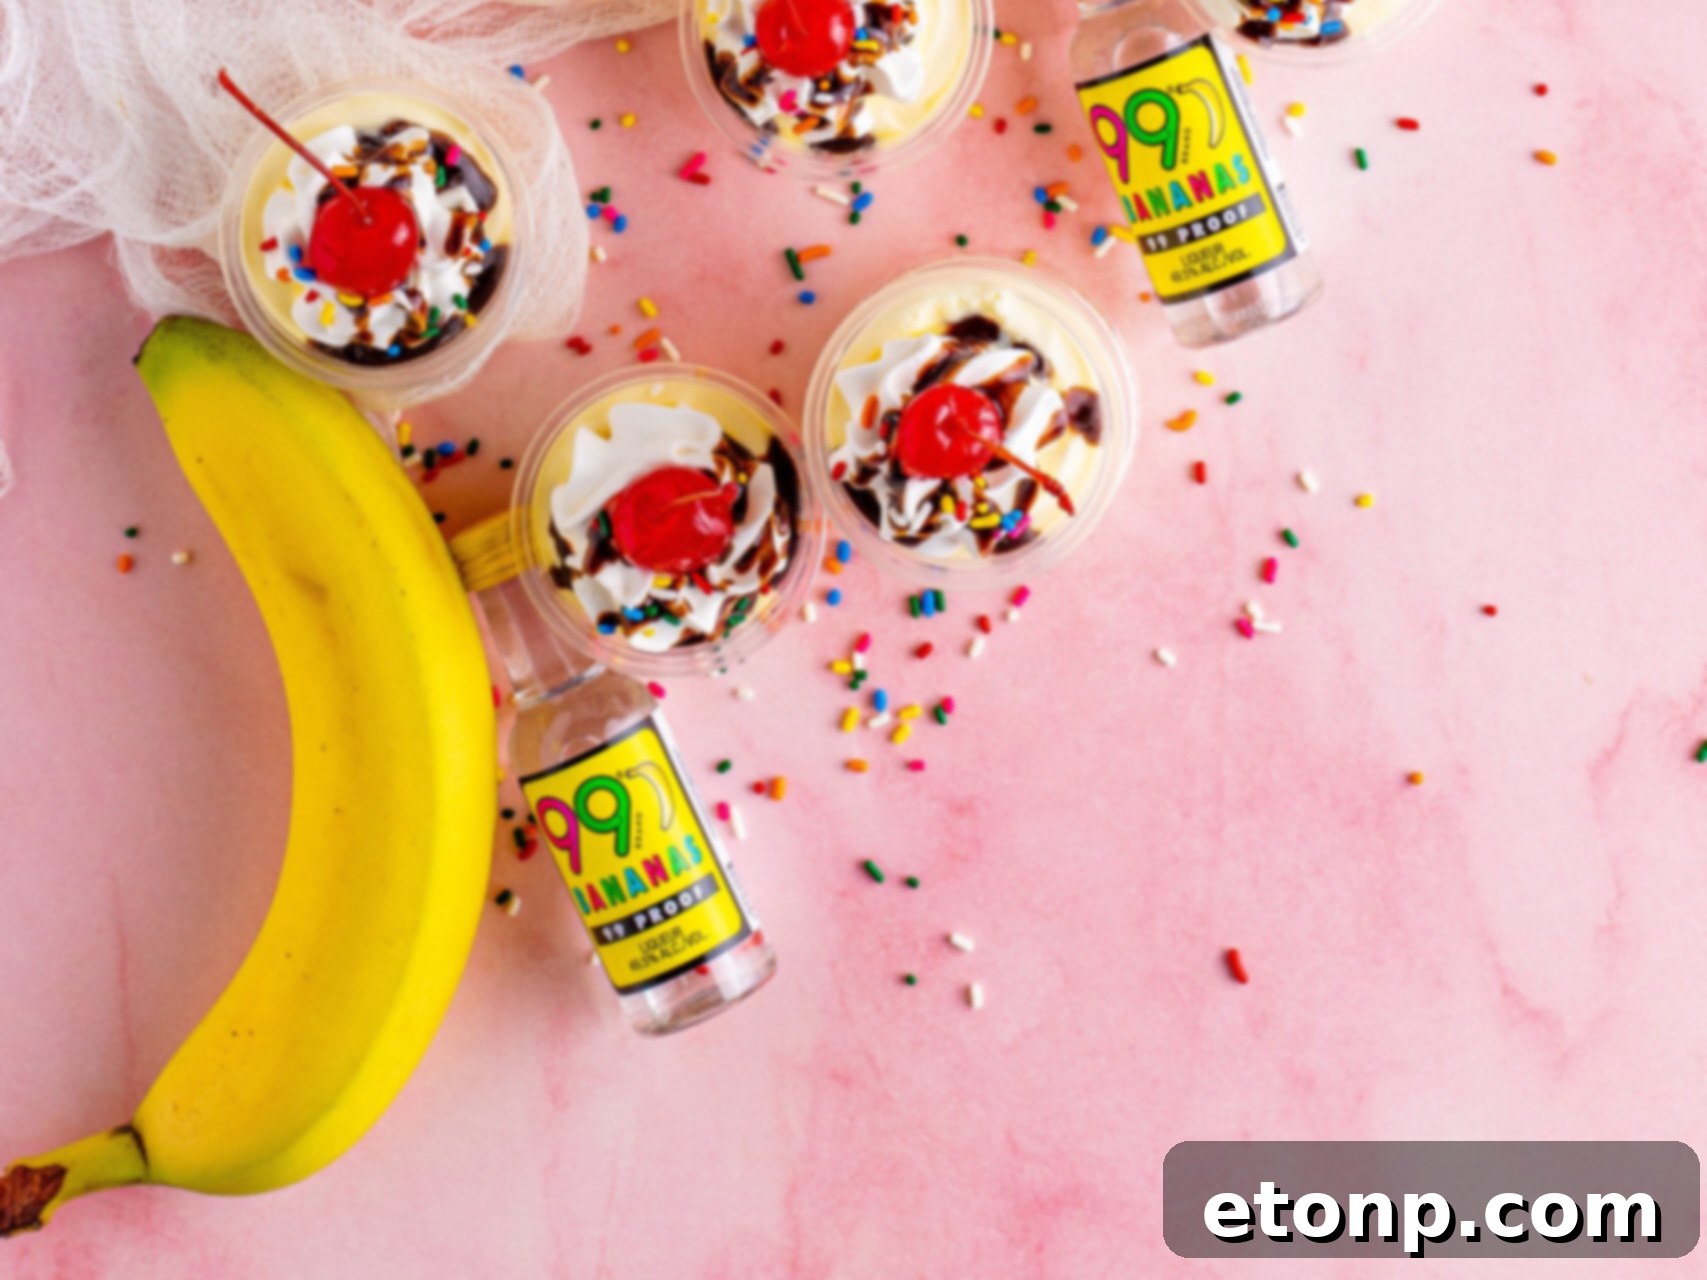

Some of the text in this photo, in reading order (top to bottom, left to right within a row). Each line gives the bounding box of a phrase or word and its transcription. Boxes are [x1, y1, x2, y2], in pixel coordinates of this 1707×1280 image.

[1089, 88, 1180, 185] 99
[1176, 201, 1248, 243] PROOF
[536, 774, 631, 876] 99
[633, 883, 703, 931] PROOF
